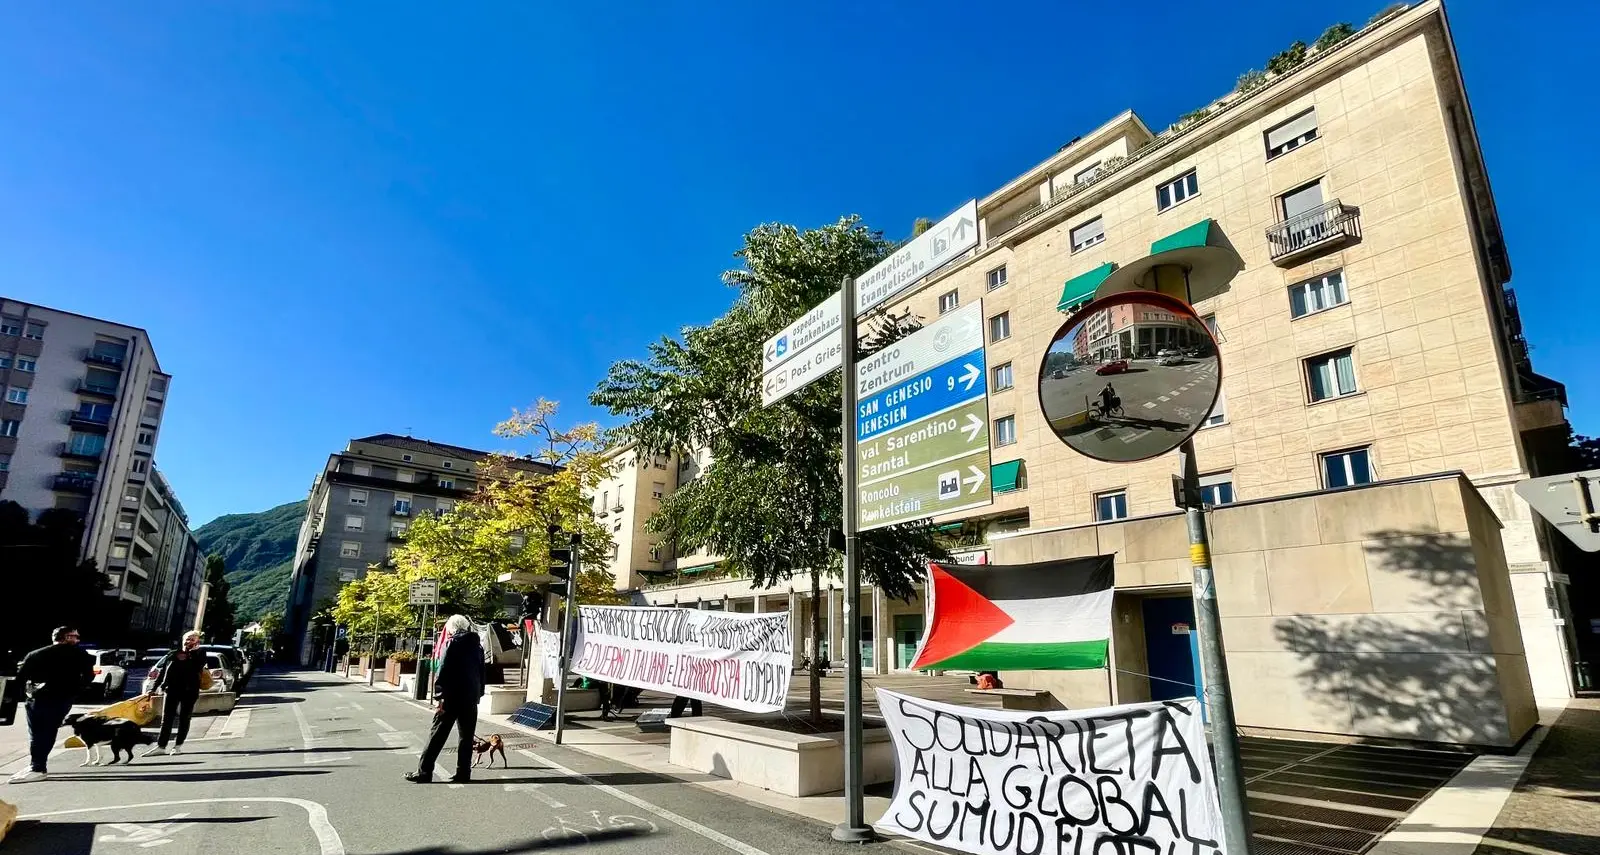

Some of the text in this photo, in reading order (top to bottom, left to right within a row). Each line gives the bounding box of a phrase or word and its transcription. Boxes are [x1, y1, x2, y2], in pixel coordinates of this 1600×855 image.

[860, 248, 912, 291] evangelica
[860, 259, 925, 307] Evangelische
[792, 309, 824, 336] ospedale
[792, 314, 840, 351] Krankenhaus
[791, 343, 842, 380] Post Gries
[860, 348, 901, 376] centro
[860, 360, 915, 395] Zentrum
[860, 376, 955, 418] SAN GENESIO 9
[860, 405, 907, 437] JENESIEN
[861, 418, 957, 461] val Sarentino
[861, 451, 910, 479] Sarntal
[861, 482, 900, 505] Roncolo
[640, 609, 691, 645] GENOCIDIO
[579, 641, 630, 680] GOVERNO
[629, 648, 669, 685] ITALIANO
[672, 654, 721, 695] LEONARDO
[721, 659, 741, 700] SPA
[910, 750, 990, 799] ALLA
[1001, 764, 1219, 849] GLOBAL
[895, 790, 1045, 855] SUMUD
